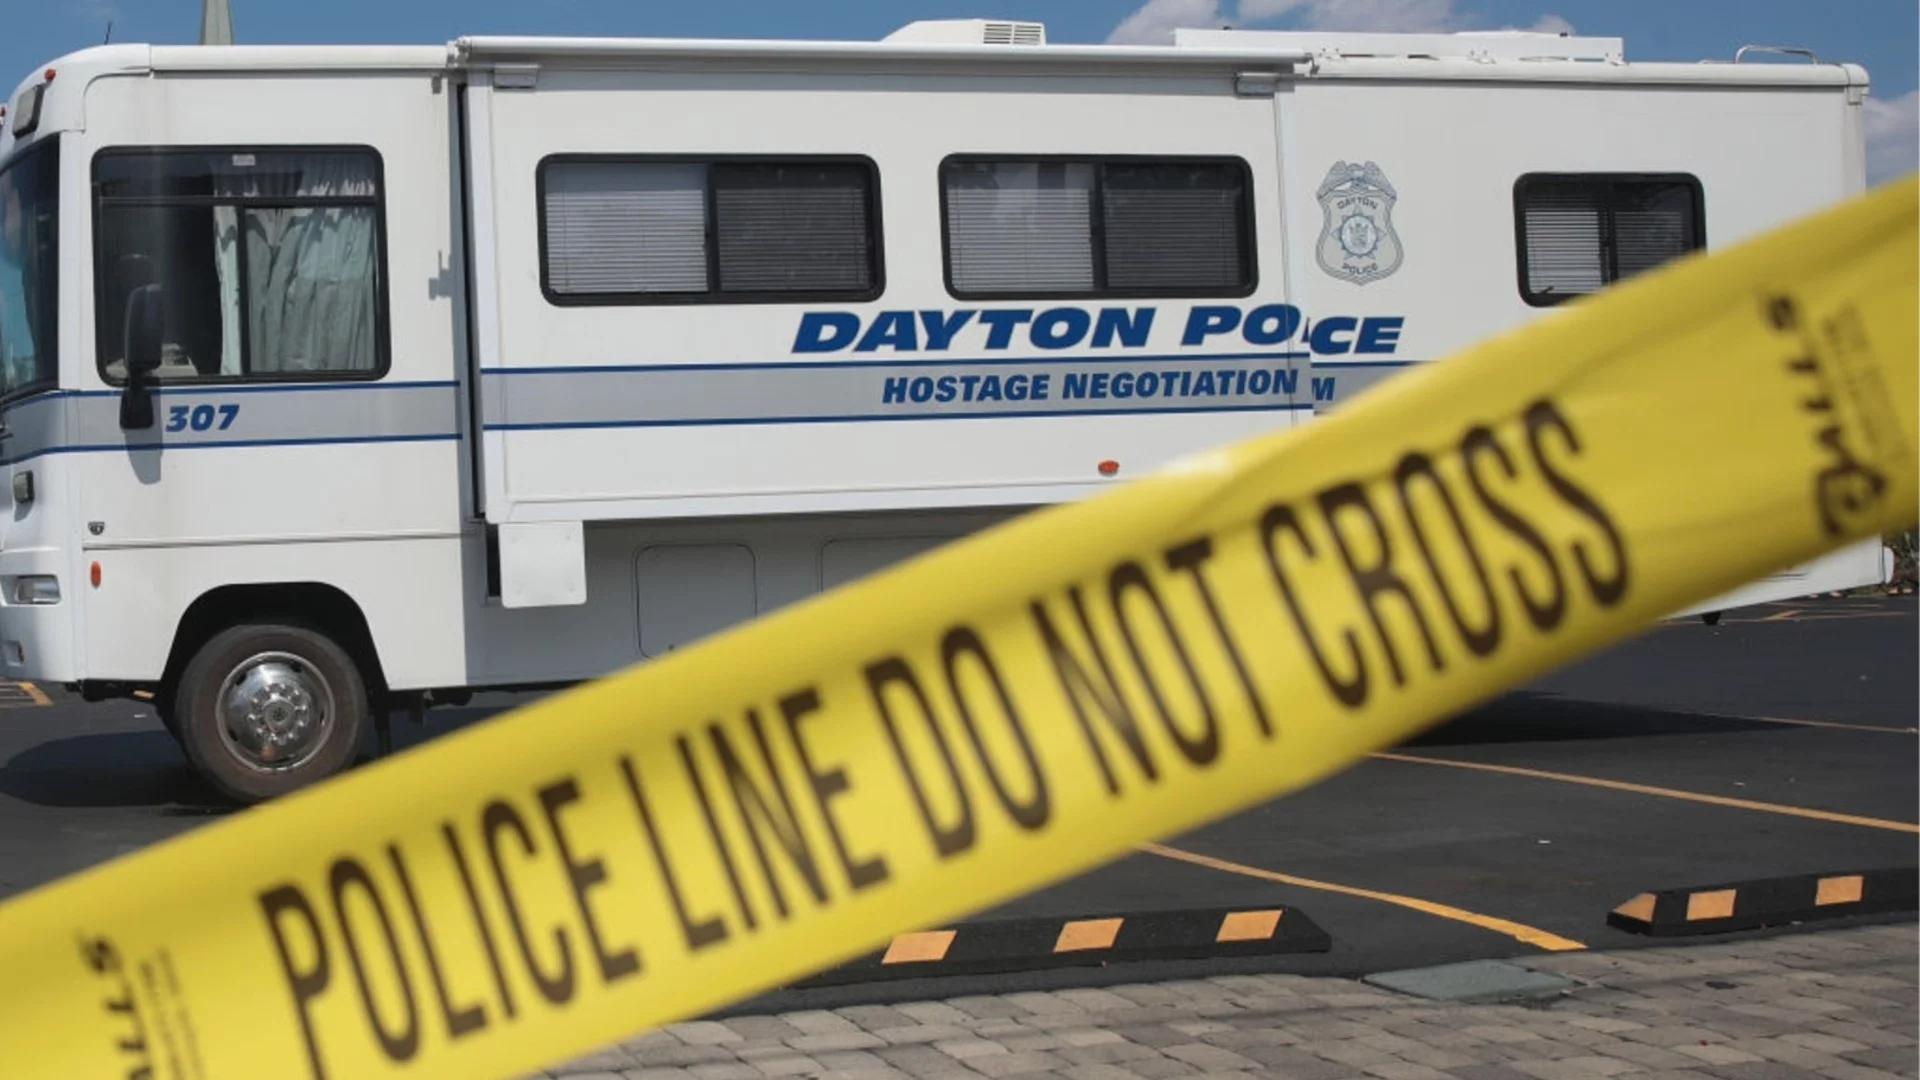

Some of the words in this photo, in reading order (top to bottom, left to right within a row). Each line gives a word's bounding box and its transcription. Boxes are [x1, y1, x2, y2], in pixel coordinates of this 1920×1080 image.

[791, 306, 1156, 354] DAYTON
[1181, 304, 1404, 355] POCE
[882, 375, 1050, 404] HOSTAGE
[1062, 369, 1298, 399] NEGOTIATION
[166, 404, 240, 433] 307
[257, 773, 643, 1080] POLICE
[617, 686, 892, 953] LINE
[862, 624, 1052, 859] DO
[1029, 536, 1275, 797] NOT
[1257, 396, 1630, 710] CROSS
